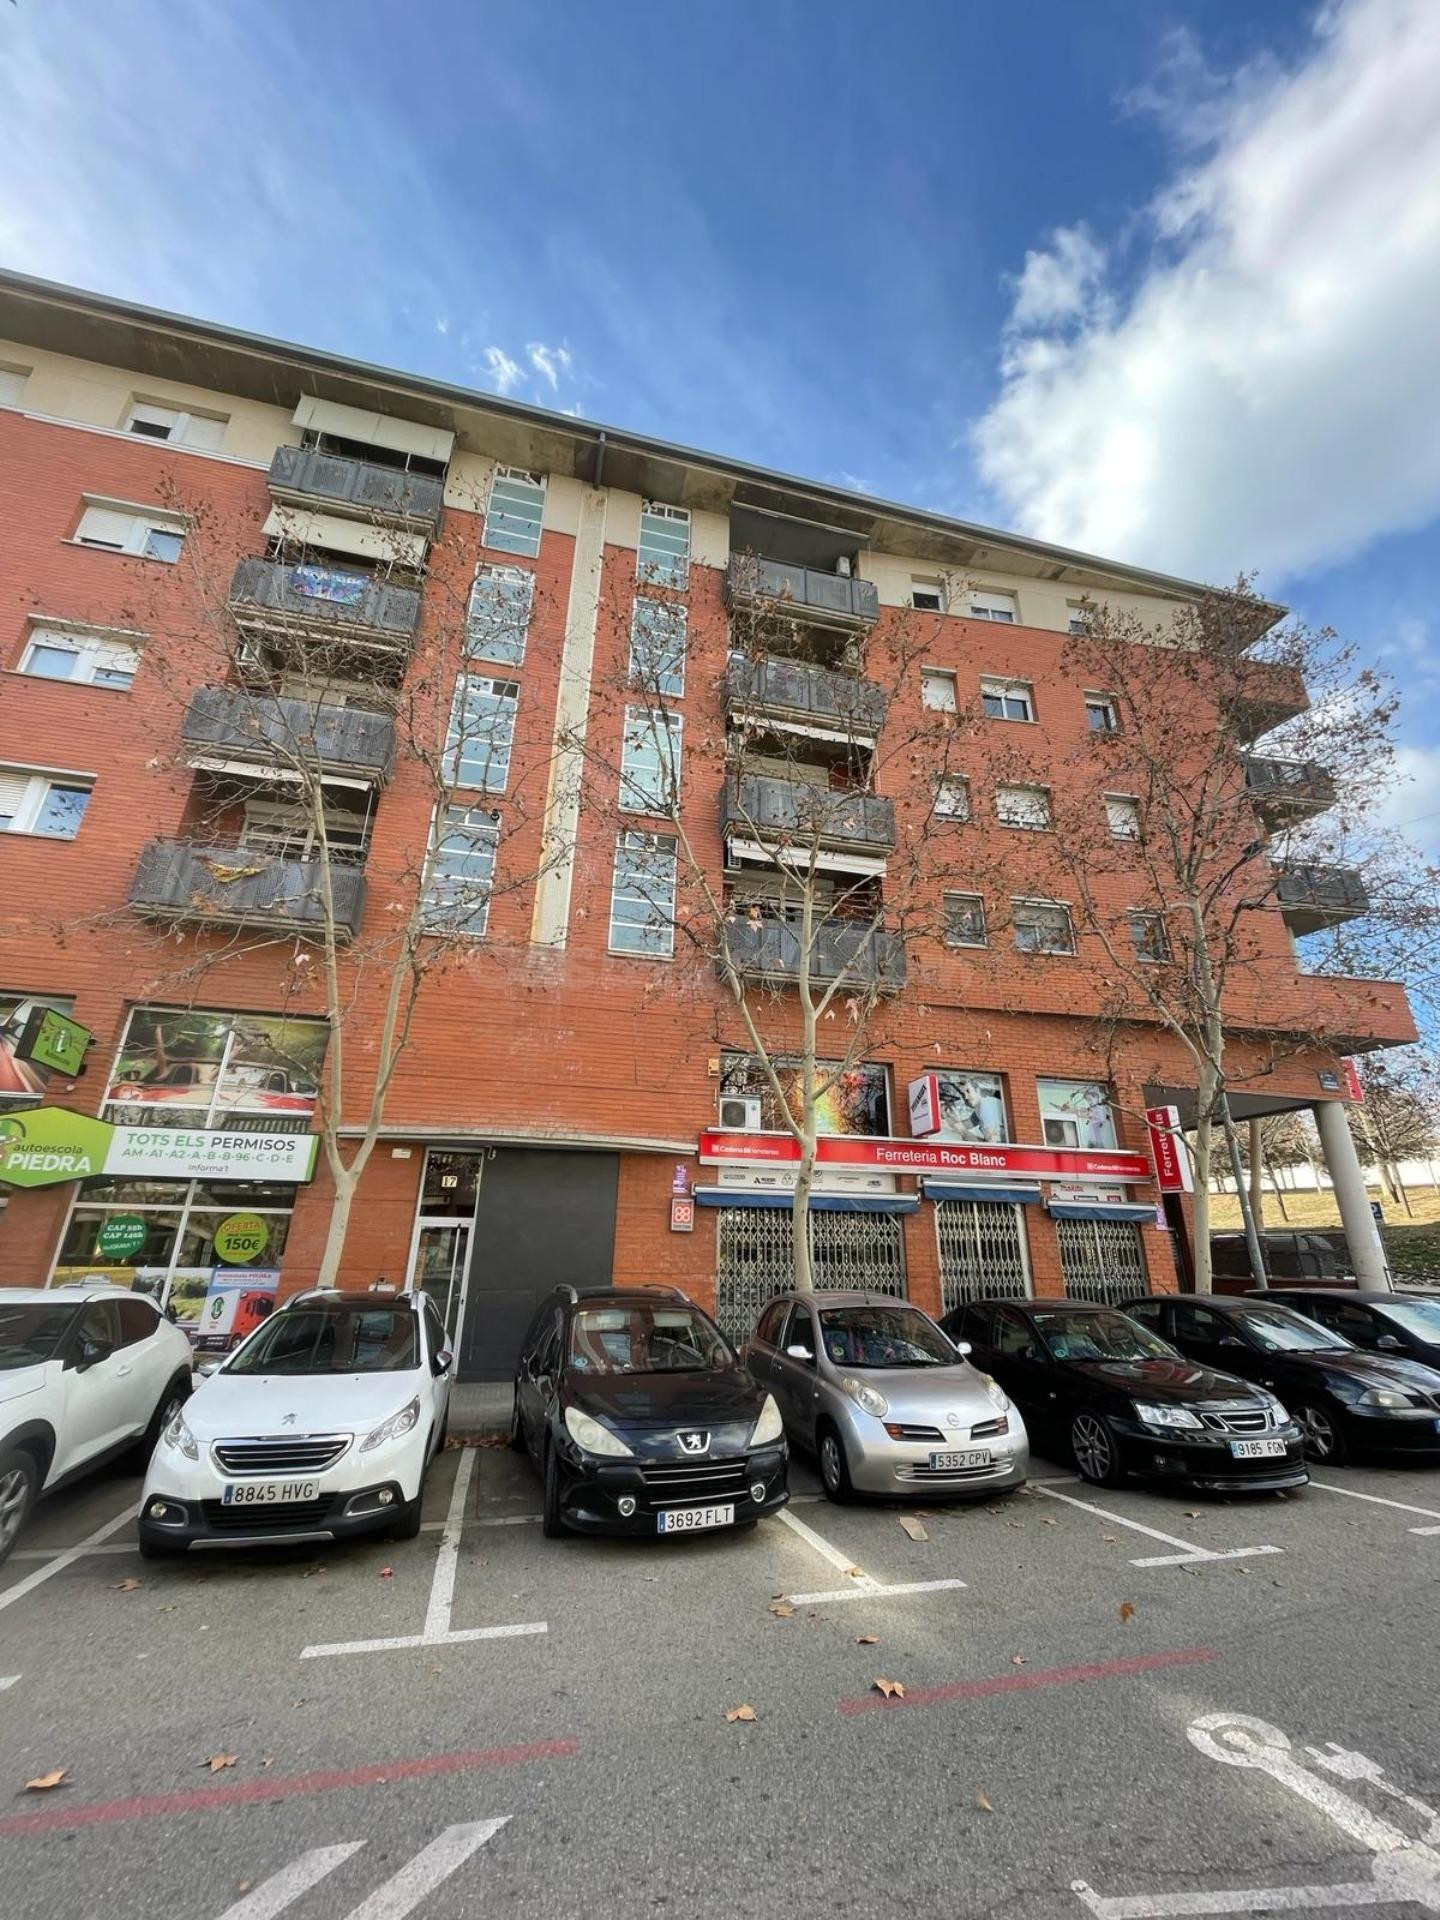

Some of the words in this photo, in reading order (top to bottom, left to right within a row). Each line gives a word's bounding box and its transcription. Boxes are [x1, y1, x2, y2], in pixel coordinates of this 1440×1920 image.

[13, 1144, 83, 1154] autoescola
[127, 1133, 170, 1147] TOTS
[175, 1135, 205, 1148] ELS
[210, 1137, 296, 1152] PERMISOS
[7, 1152, 91, 1172] PIEDRA
[876, 1148, 937, 1164] Ferreteria
[940, 1151, 966, 1165] Roc
[970, 1153, 1006, 1167] Blanc
[443, 1176, 457, 1187] 17
[224, 1238, 260, 1250] 150€
[1238, 1442, 1263, 1455] 9185
[938, 1454, 966, 1468] 5352
[968, 1451, 988, 1466] CPV
[235, 1485, 276, 1502] 8845
[281, 1482, 314, 1500] HVG
[667, 1511, 703, 1529] 3692
[706, 1507, 731, 1525] FLT
